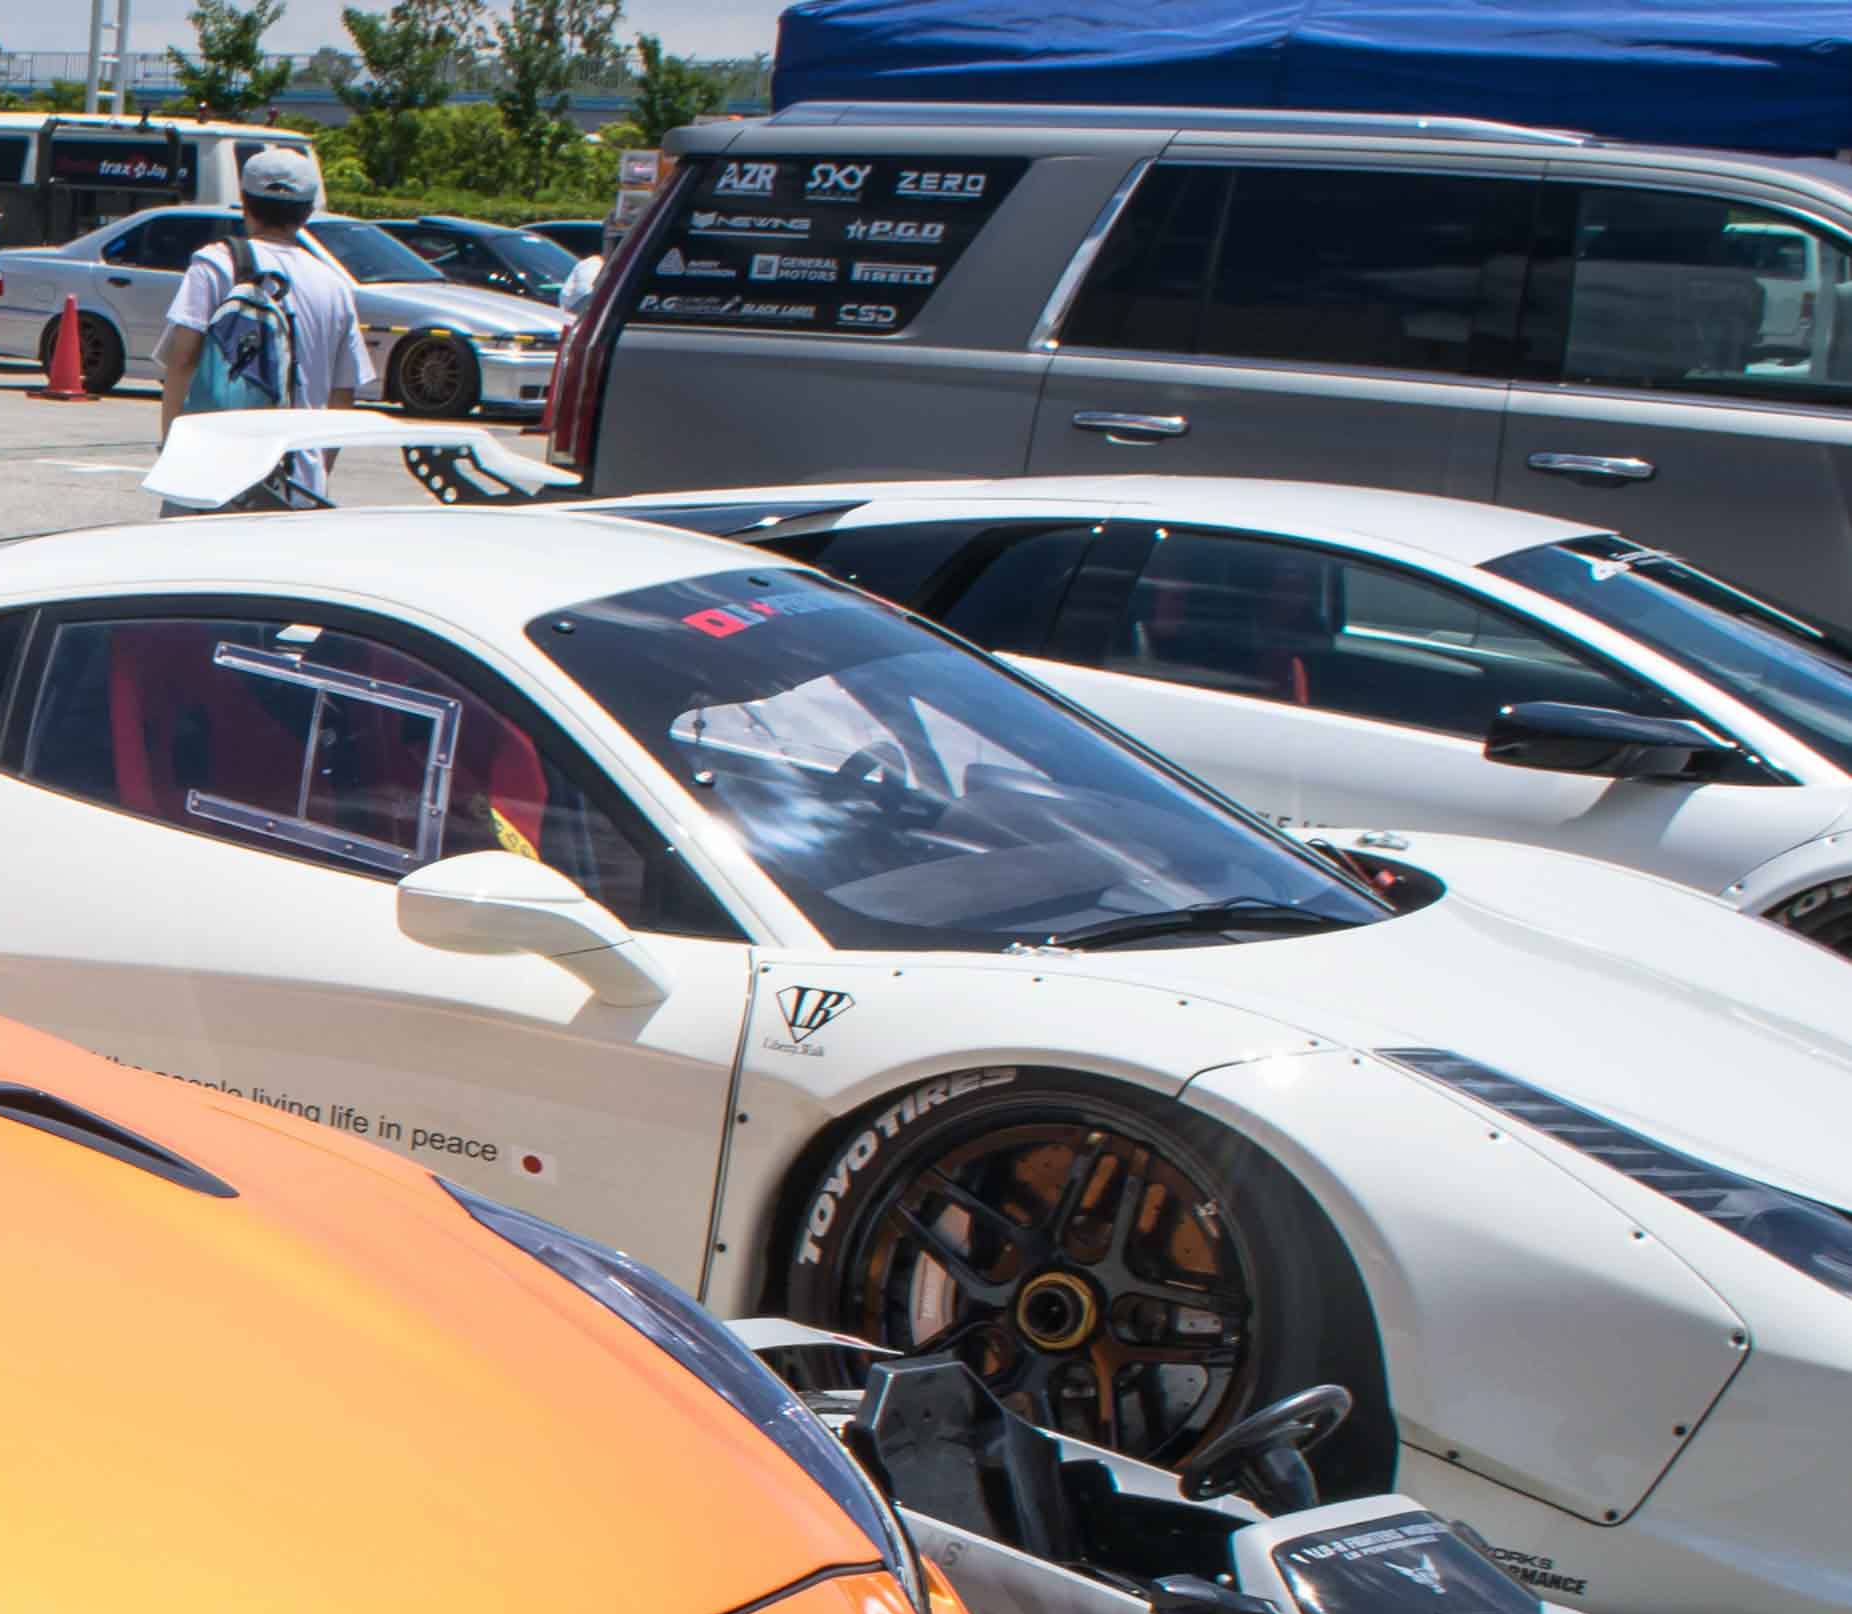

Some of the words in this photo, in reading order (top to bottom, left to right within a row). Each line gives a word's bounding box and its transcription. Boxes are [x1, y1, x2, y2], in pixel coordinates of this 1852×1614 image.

[717, 162, 777, 192] AZR
[897, 170, 987, 193] ZERO
[780, 256, 839, 270] GENERAL
[851, 260, 937, 285] PIRELLI
[777, 268, 838, 283] MOTORS
[330, 1104, 370, 1136] life
[378, 1114, 402, 1142] in
[411, 1127, 498, 1162] peace
[797, 1130, 879, 1265] TOYO
[1487, 1547, 1553, 1570] ORKS
